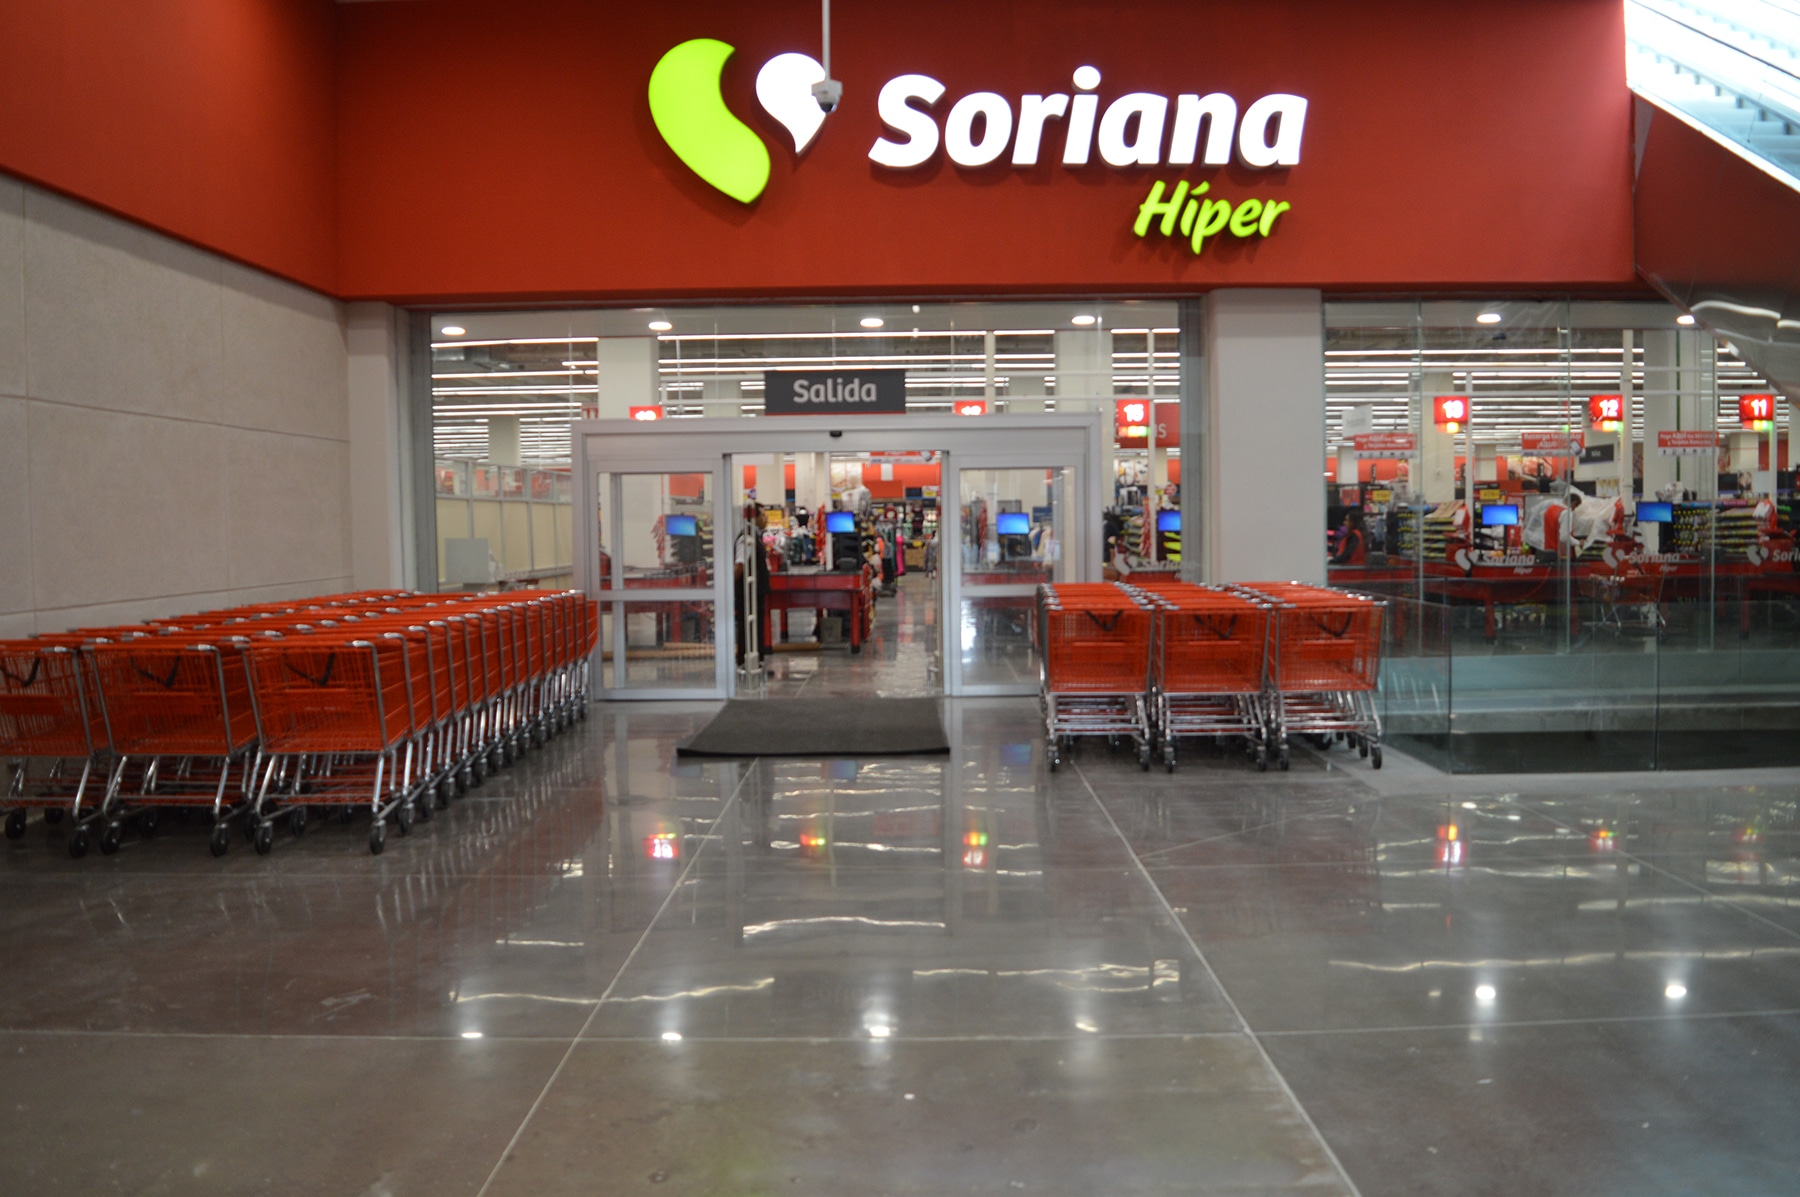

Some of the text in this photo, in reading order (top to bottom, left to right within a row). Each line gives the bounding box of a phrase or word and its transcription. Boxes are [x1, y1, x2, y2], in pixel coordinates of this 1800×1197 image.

[867, 65, 1308, 168] Soriana
[1132, 179, 1291, 255] Híper
[792, 377, 877, 403] Salida
[1599, 399, 1619, 417] 12
[1751, 399, 1768, 416] 11
[1482, 550, 1536, 566] Soriana
[1771, 546, 1800, 563] Sori
